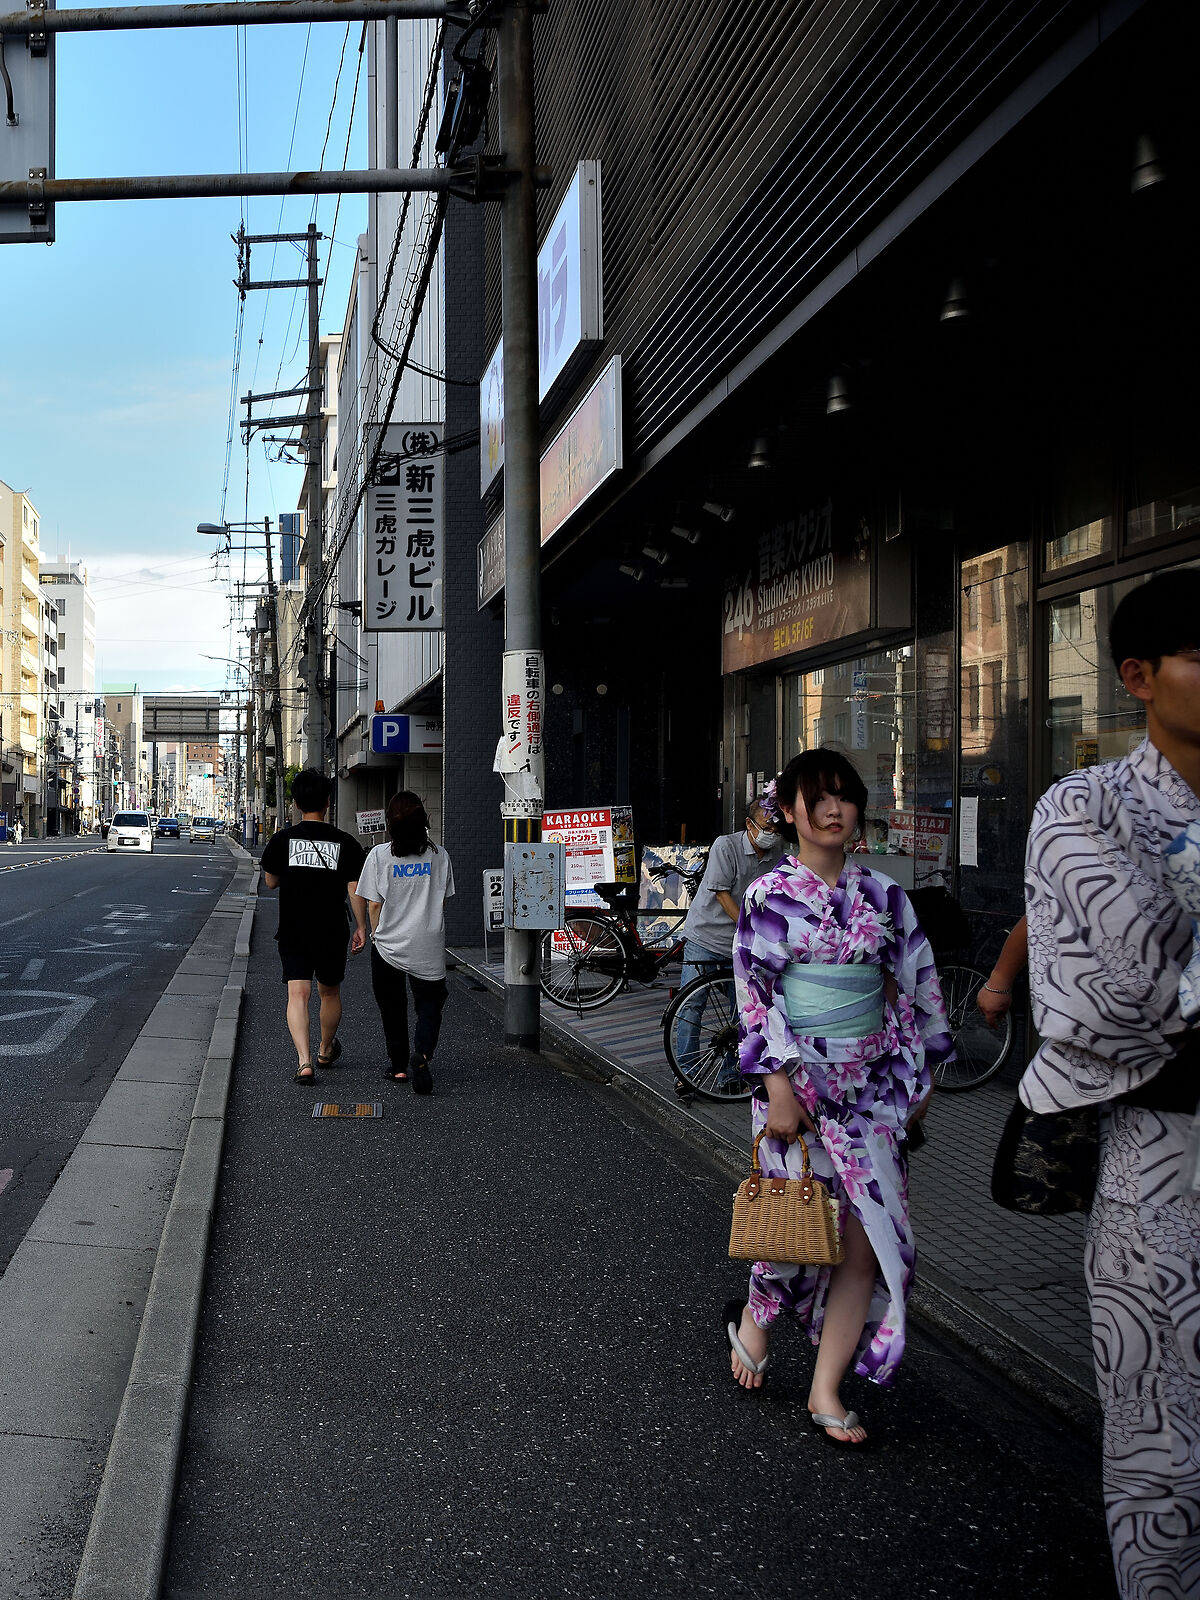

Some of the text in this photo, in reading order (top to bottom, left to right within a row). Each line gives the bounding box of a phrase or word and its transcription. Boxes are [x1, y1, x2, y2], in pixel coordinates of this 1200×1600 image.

[374, 493, 397, 620] 三虎ガレージ
[724, 552, 834, 641] 246 Studio246 KYOTO
[792, 616, 814, 645] 5F/6F
[525, 656, 541, 755] 自転車の右側通行は
[382, 721, 399, 747] P
[546, 811, 606, 826] KARAOKE
[564, 833, 598, 843] ジャンカラ
[290, 840, 339, 861] JORDAN
[393, 862, 432, 878] NCAA
[554, 943, 570, 951] FREE
